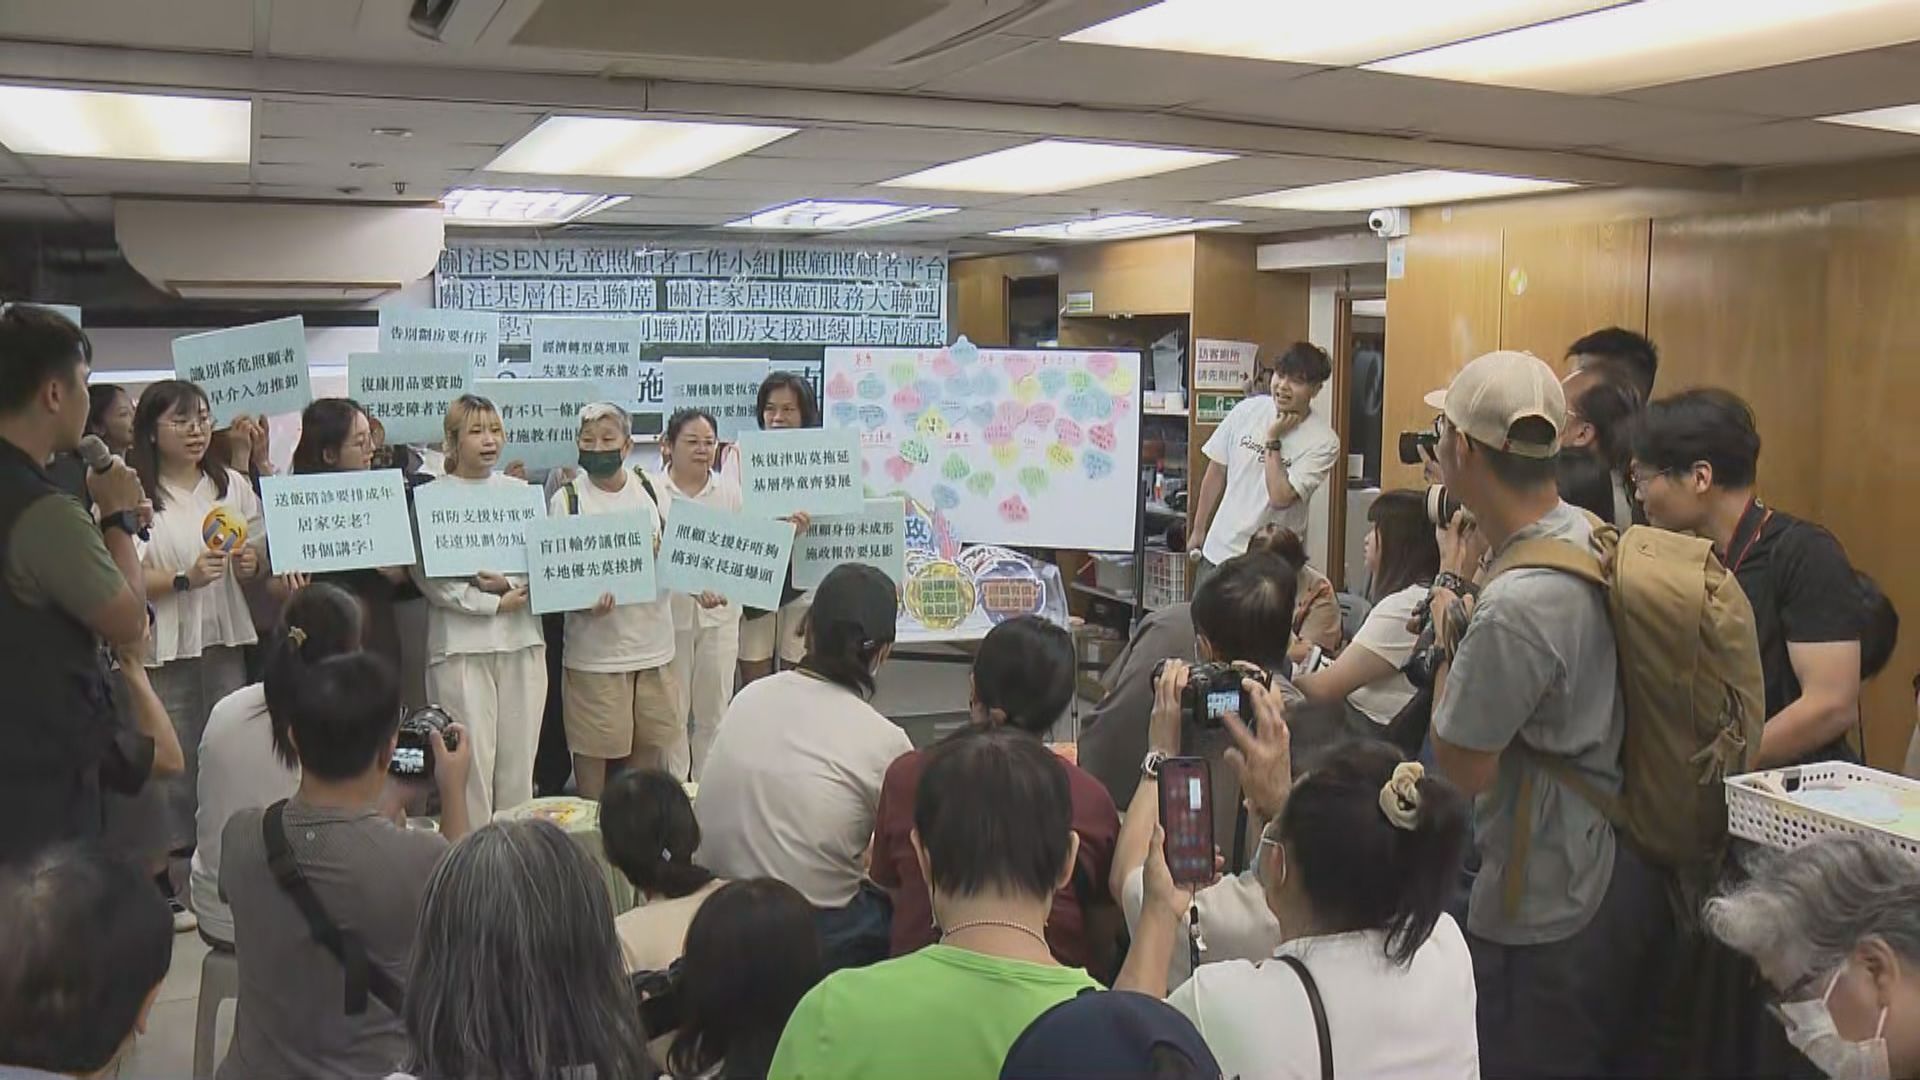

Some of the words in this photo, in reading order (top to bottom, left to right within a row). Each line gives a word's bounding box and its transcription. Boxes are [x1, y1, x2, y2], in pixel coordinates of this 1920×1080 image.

[438, 247, 777, 275] 關注SEN兒童照顧者工作小組
[784, 249, 944, 280] 照顧照顧者平台
[440, 282, 653, 309] 關注基層住屋聯席
[670, 282, 936, 313] 關注家居照顧服務大聯盟
[391, 326, 487, 344] 告別劏房要有序
[711, 316, 851, 342] 劏房支援連線
[858, 318, 944, 345] 基層願景
[542, 340, 630, 355] 經濟轉型莫埋單
[190, 347, 295, 382] 識別高危照顧者
[543, 364, 629, 377] 失業安全要承擔
[211, 374, 298, 405] 早介入勿推卸
[361, 375, 463, 392] 復康用品要資助
[752, 450, 849, 467] 恢復津貼莫拖延
[753, 474, 851, 492] 基層學童齊發展
[275, 487, 394, 507] 送飯陪診要排成年
[431, 508, 535, 524] 預防支援好重要
[806, 522, 894, 538] 照顧身份未成形
[540, 531, 641, 555] 盲目輸勞議價低
[676, 524, 779, 559] 照顧支援好唔夠
[806, 544, 893, 561] 施政報告要見影
[543, 557, 643, 581] 本地優先莫挨擠
